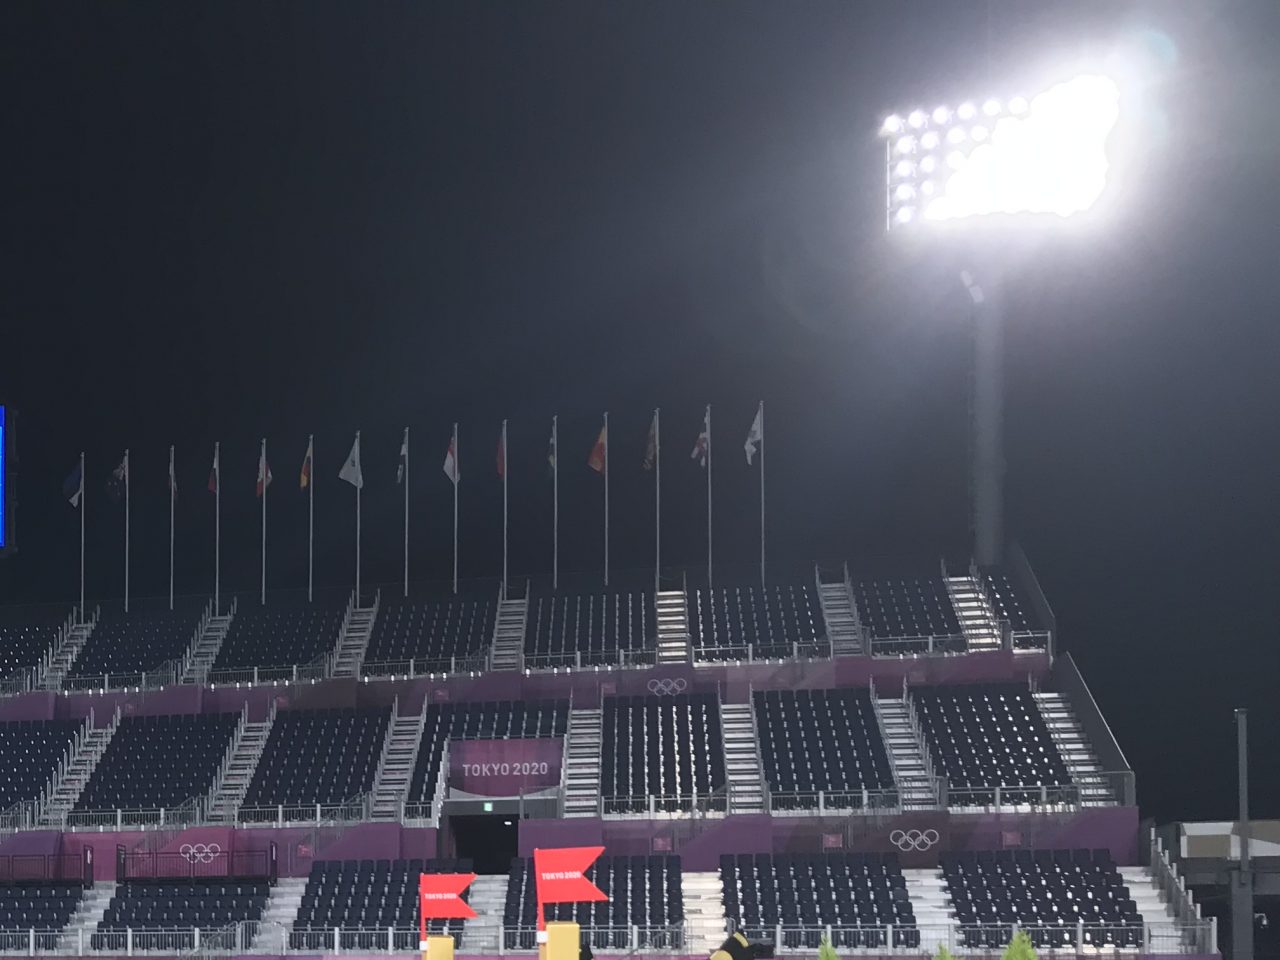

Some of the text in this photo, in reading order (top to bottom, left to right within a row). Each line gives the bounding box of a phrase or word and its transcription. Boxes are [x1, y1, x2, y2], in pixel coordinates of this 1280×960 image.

[462, 762, 549, 776] TOKYO 2020
[541, 871, 582, 880] TOKYO 2020
[425, 892, 443, 900] TOKYO
